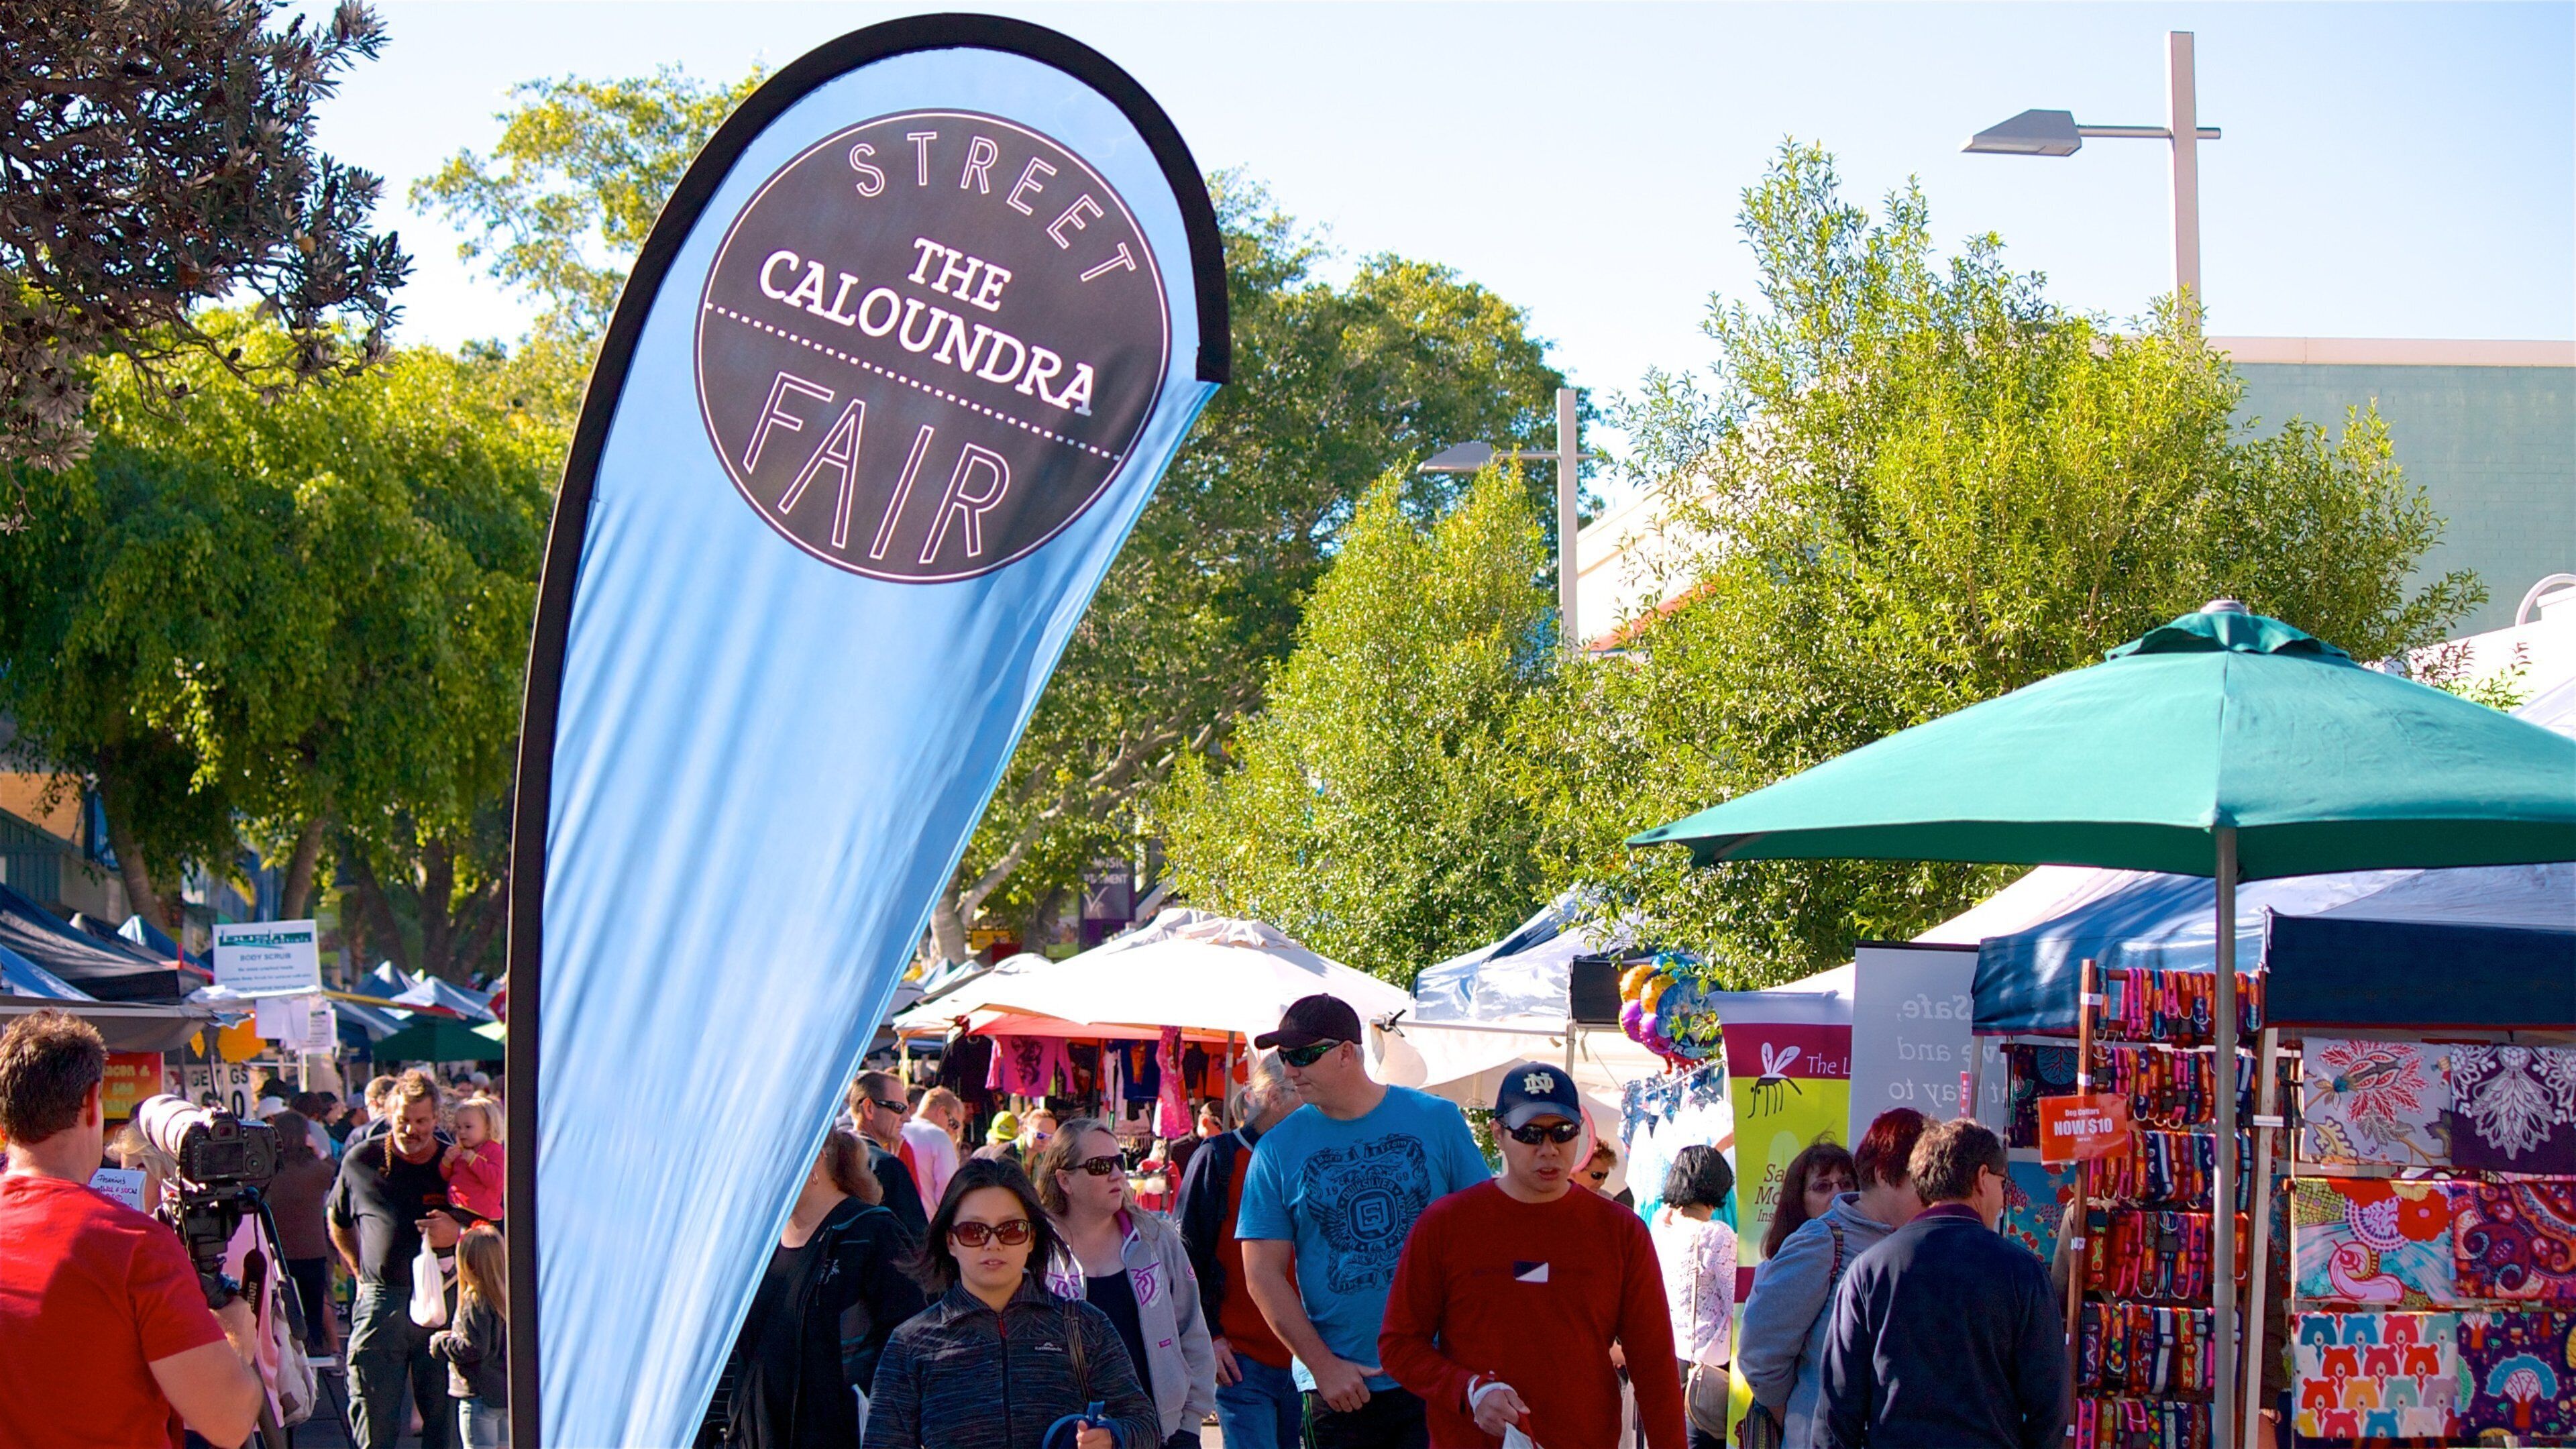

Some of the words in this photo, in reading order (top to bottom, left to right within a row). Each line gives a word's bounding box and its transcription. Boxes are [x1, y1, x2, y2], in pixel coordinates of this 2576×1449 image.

[849, 131, 1138, 283] STREET
[908, 237, 1012, 312] THE
[759, 250, 1093, 417] CALOUNDRA
[743, 370, 1010, 564] FAIR
[239, 954, 262, 962] BODY
[264, 953, 291, 961] SCRUB
[1807, 1053, 1837, 1074] The
[2064, 1109, 2077, 1117] Dog
[2078, 1108, 2100, 1116] Collars
[2054, 1120, 2086, 1136] NOW
[2088, 1118, 2113, 1134] $10
[1325, 1186, 1339, 1197] 19
[1395, 1172, 1409, 1182] 69
[1342, 1179, 1395, 1201] QUIKSILVER
